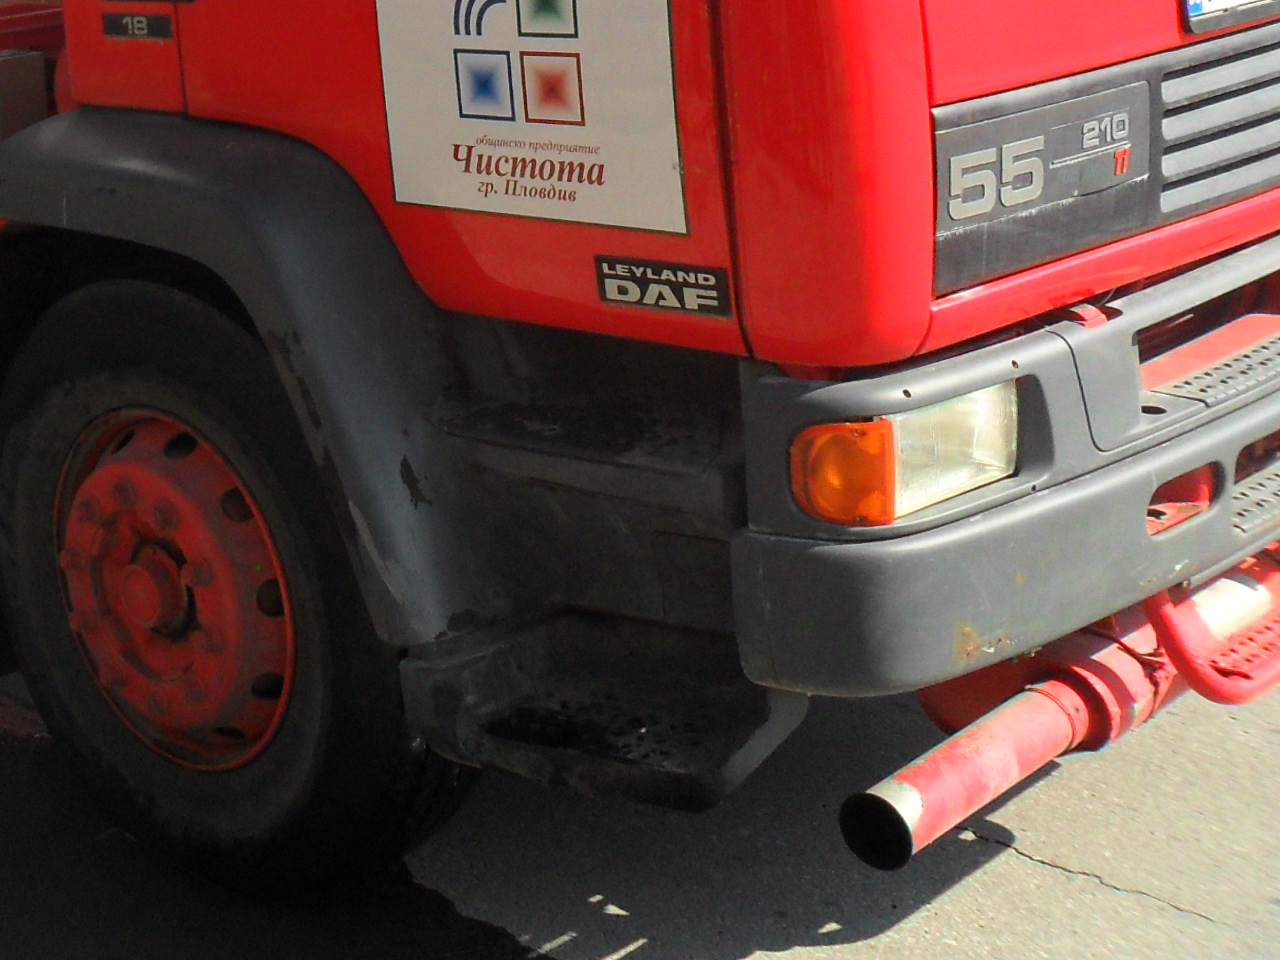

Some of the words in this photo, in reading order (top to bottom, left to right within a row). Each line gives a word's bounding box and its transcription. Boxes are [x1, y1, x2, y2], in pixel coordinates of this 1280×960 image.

[122, 15, 148, 35] 18
[1082, 112, 1130, 149] 210
[475, 135, 526, 150] общинско
[528, 141, 601, 155] предприятие
[452, 143, 606, 186] Чистота
[948, 135, 1045, 220] 55
[477, 181, 498, 198] гр.
[504, 179, 577, 202] Пловдив
[602, 262, 717, 286] LEYLAND
[604, 278, 719, 310] DAF
